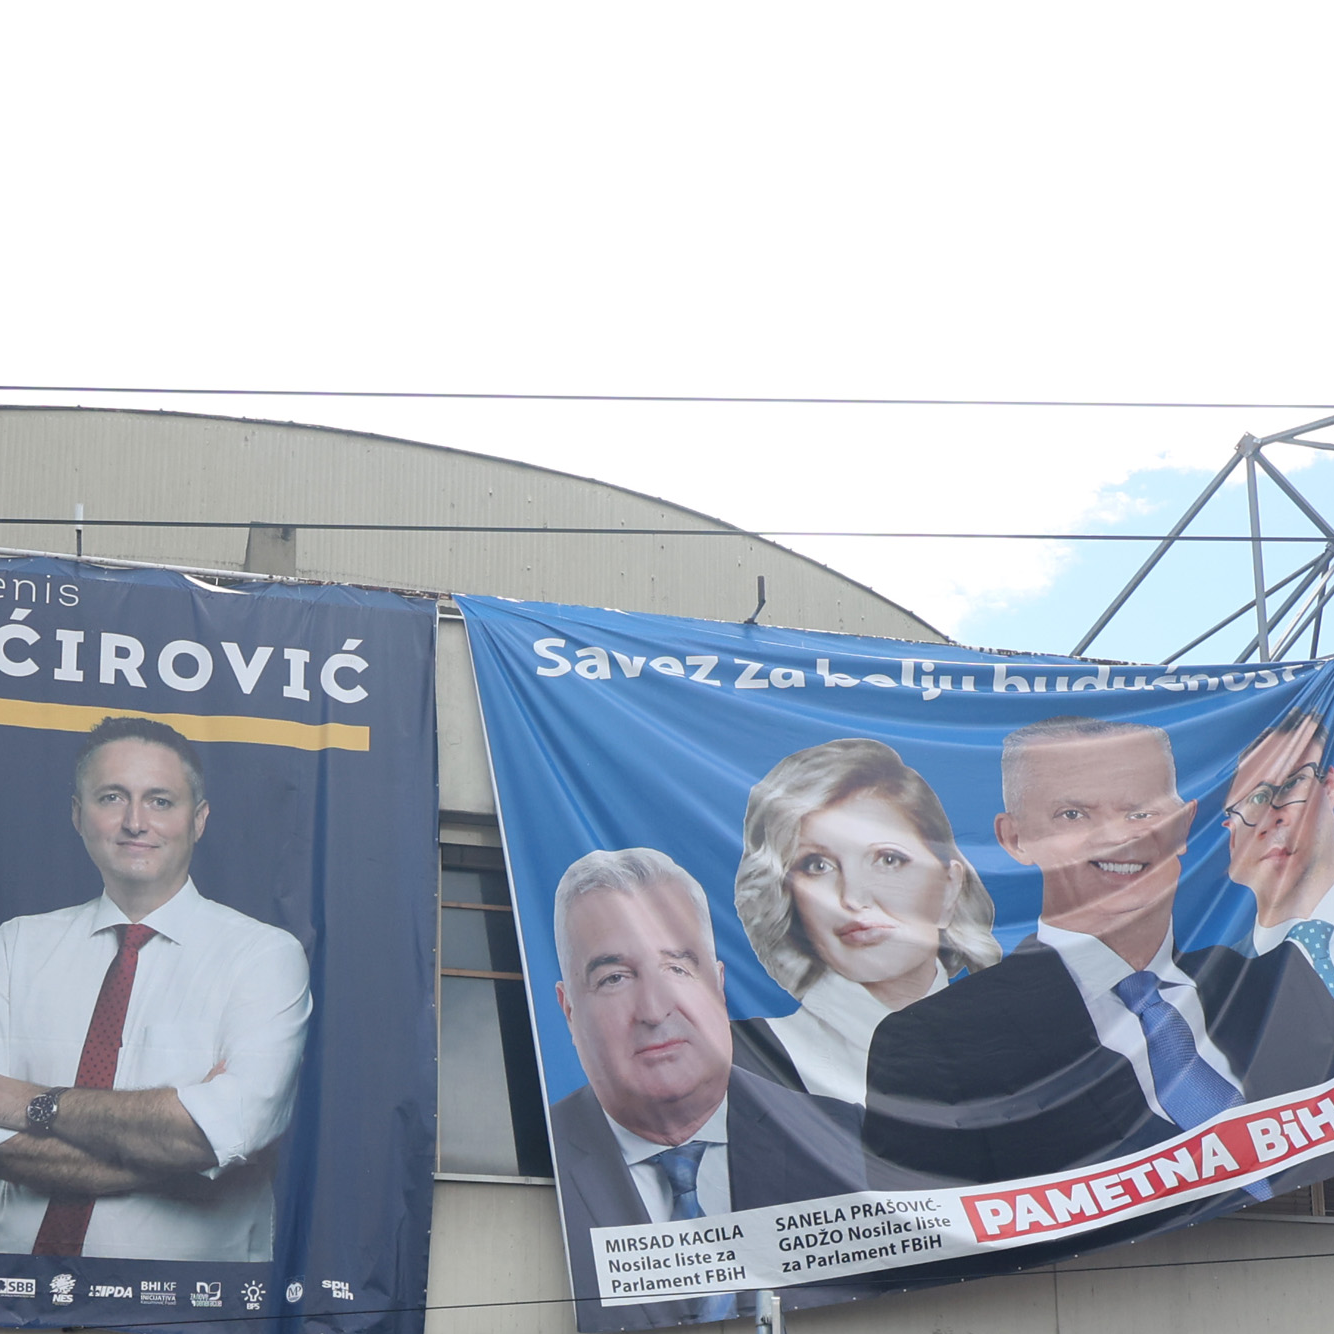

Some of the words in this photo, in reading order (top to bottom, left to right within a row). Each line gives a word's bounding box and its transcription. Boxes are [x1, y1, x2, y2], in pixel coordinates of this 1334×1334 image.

[532, 637, 722, 687] Savez
[733, 658, 806, 689] za
[975, 1132, 1240, 1236] PAMETNA
[776, 1208, 847, 1232] SANELA
[778, 1228, 844, 1252] GADŽO
[847, 1220, 912, 1242] Nosilac
[916, 1215, 952, 1231] liste
[605, 1234, 675, 1254] MIRSAD
[679, 1224, 744, 1246] KACILA
[608, 1256, 672, 1274] Nosilac
[675, 1250, 712, 1267] liste
[716, 1249, 736, 1262] za
[781, 1259, 802, 1273] za
[805, 1248, 898, 1270] Parlament
[901, 1234, 943, 1255] FBiH
[8, 1281, 34, 1293] SBB
[141, 1281, 161, 1291] BHI
[163, 1282, 177, 1291] KF
[611, 1272, 702, 1293] Parlament
[705, 1266, 746, 1284] FBiH
[52, 1294, 74, 1303] NES
